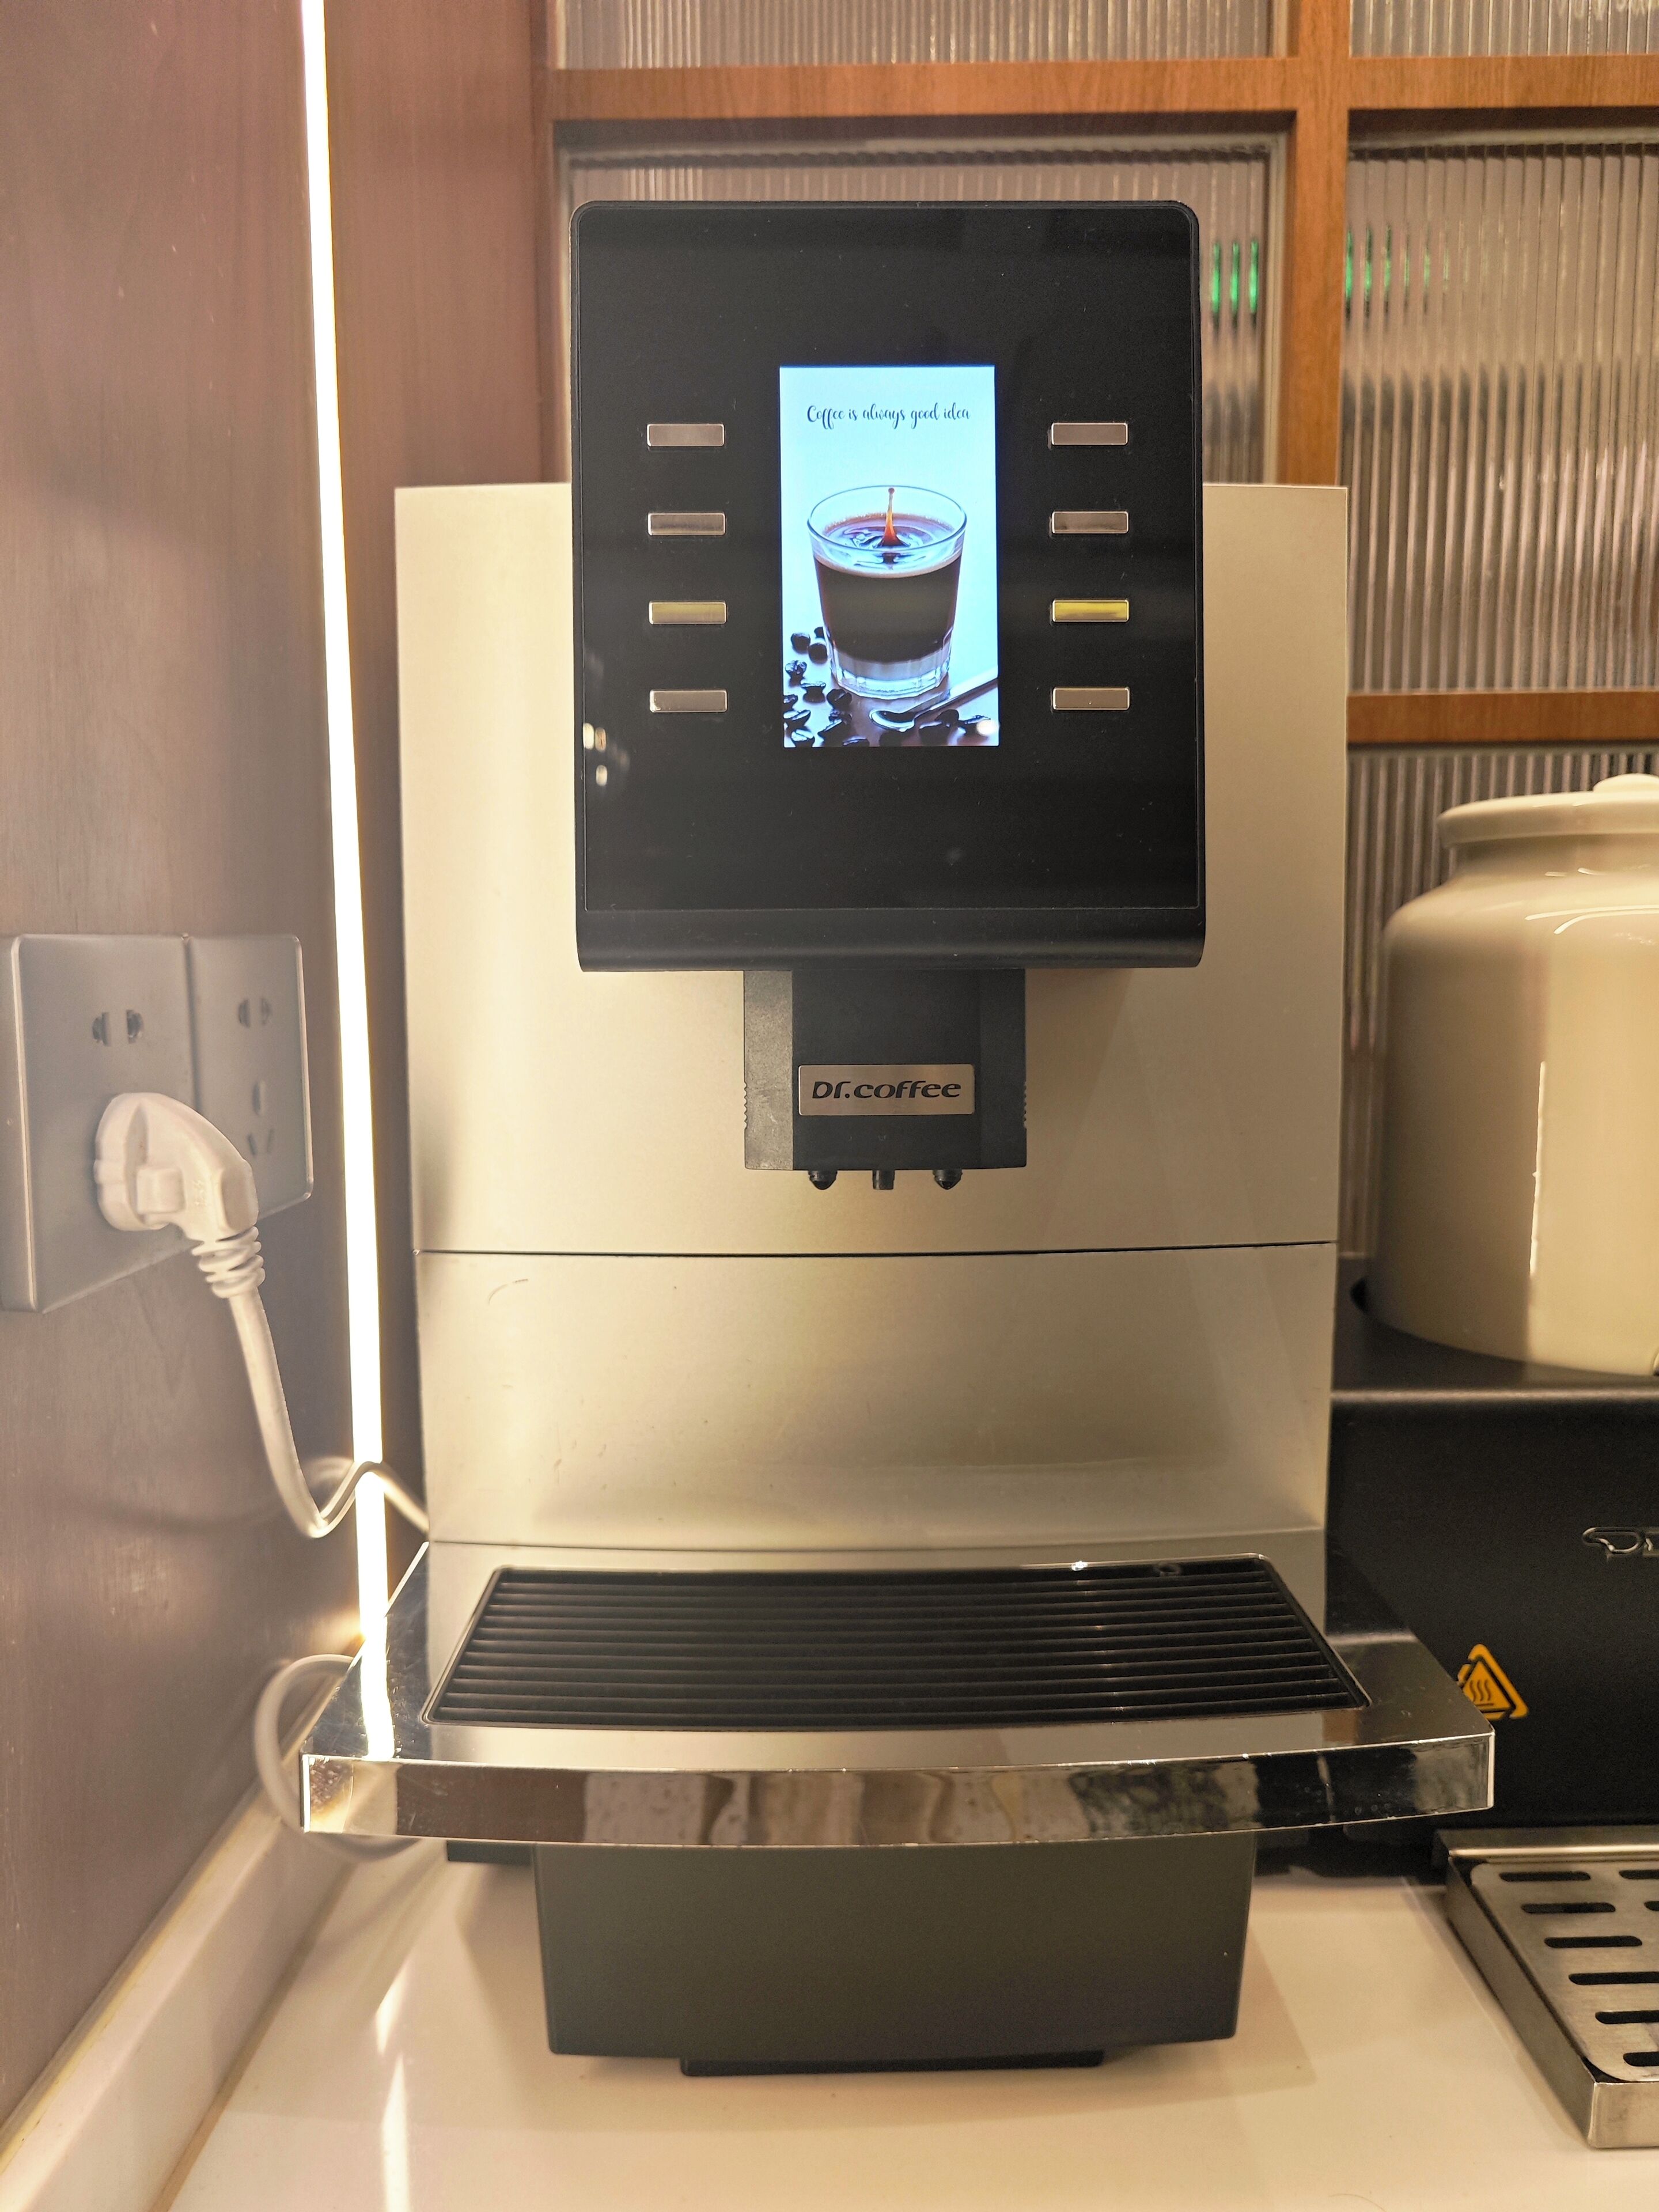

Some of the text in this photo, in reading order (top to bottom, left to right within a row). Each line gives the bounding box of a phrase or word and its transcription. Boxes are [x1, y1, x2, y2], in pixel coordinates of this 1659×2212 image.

[807, 402, 971, 430] Coffee is always good idea
[812, 1081, 961, 1099] Dr.coffee
